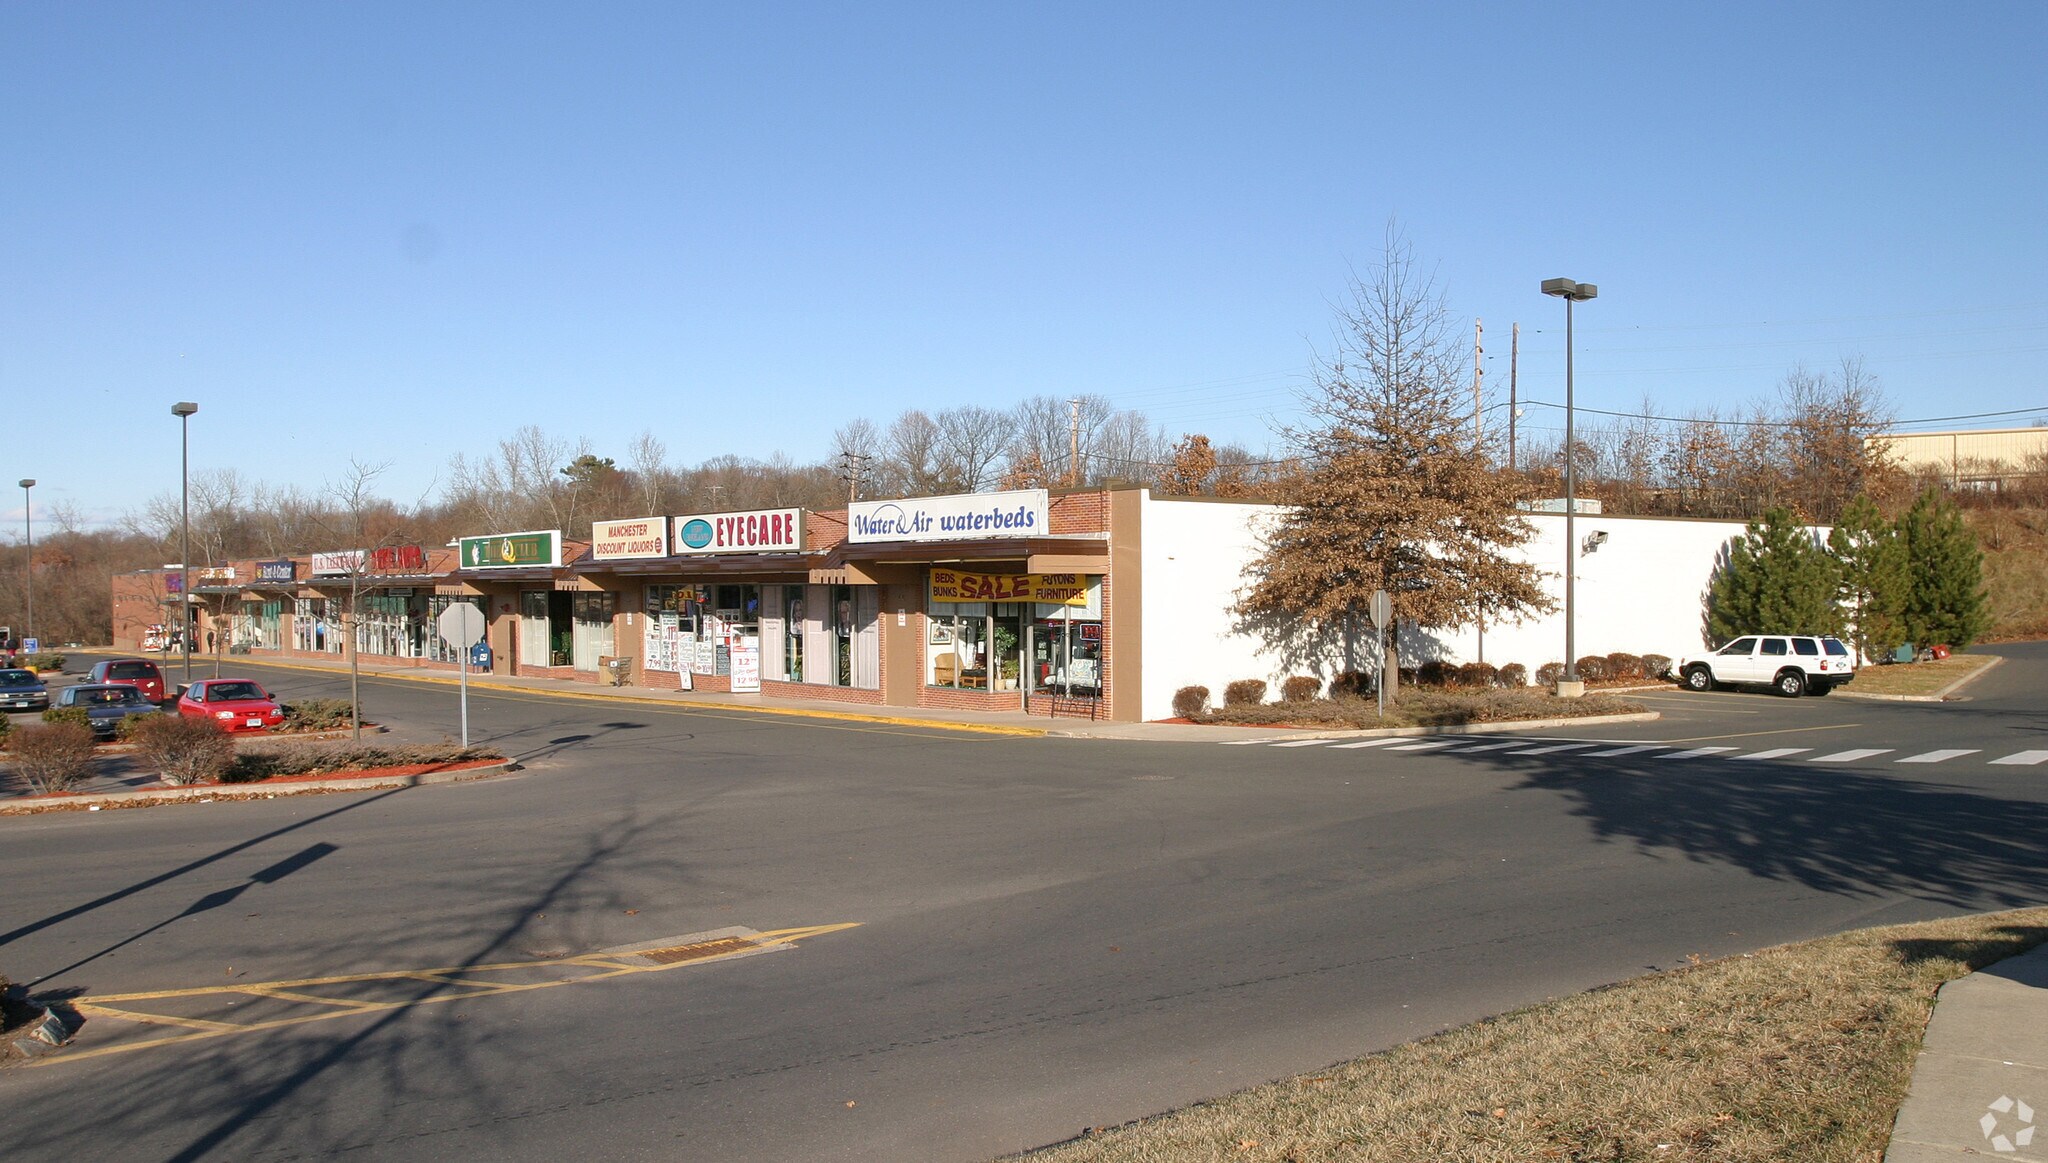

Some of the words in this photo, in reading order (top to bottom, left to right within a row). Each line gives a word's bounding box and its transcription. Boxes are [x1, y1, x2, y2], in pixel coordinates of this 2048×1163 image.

[855, 513, 895, 536] Water
[911, 510, 933, 533] Air
[940, 505, 1035, 532] waterbeds
[608, 523, 648, 538] MANCHESTER
[716, 513, 793, 547] EYECARE
[596, 541, 627, 555] DISCOUNT
[627, 539, 655, 554] LIQUORS
[934, 572, 956, 584] BEDS
[933, 586, 958, 598] BUNKS
[959, 574, 1030, 600] SALE
[1035, 587, 1085, 600] FURNITURE
